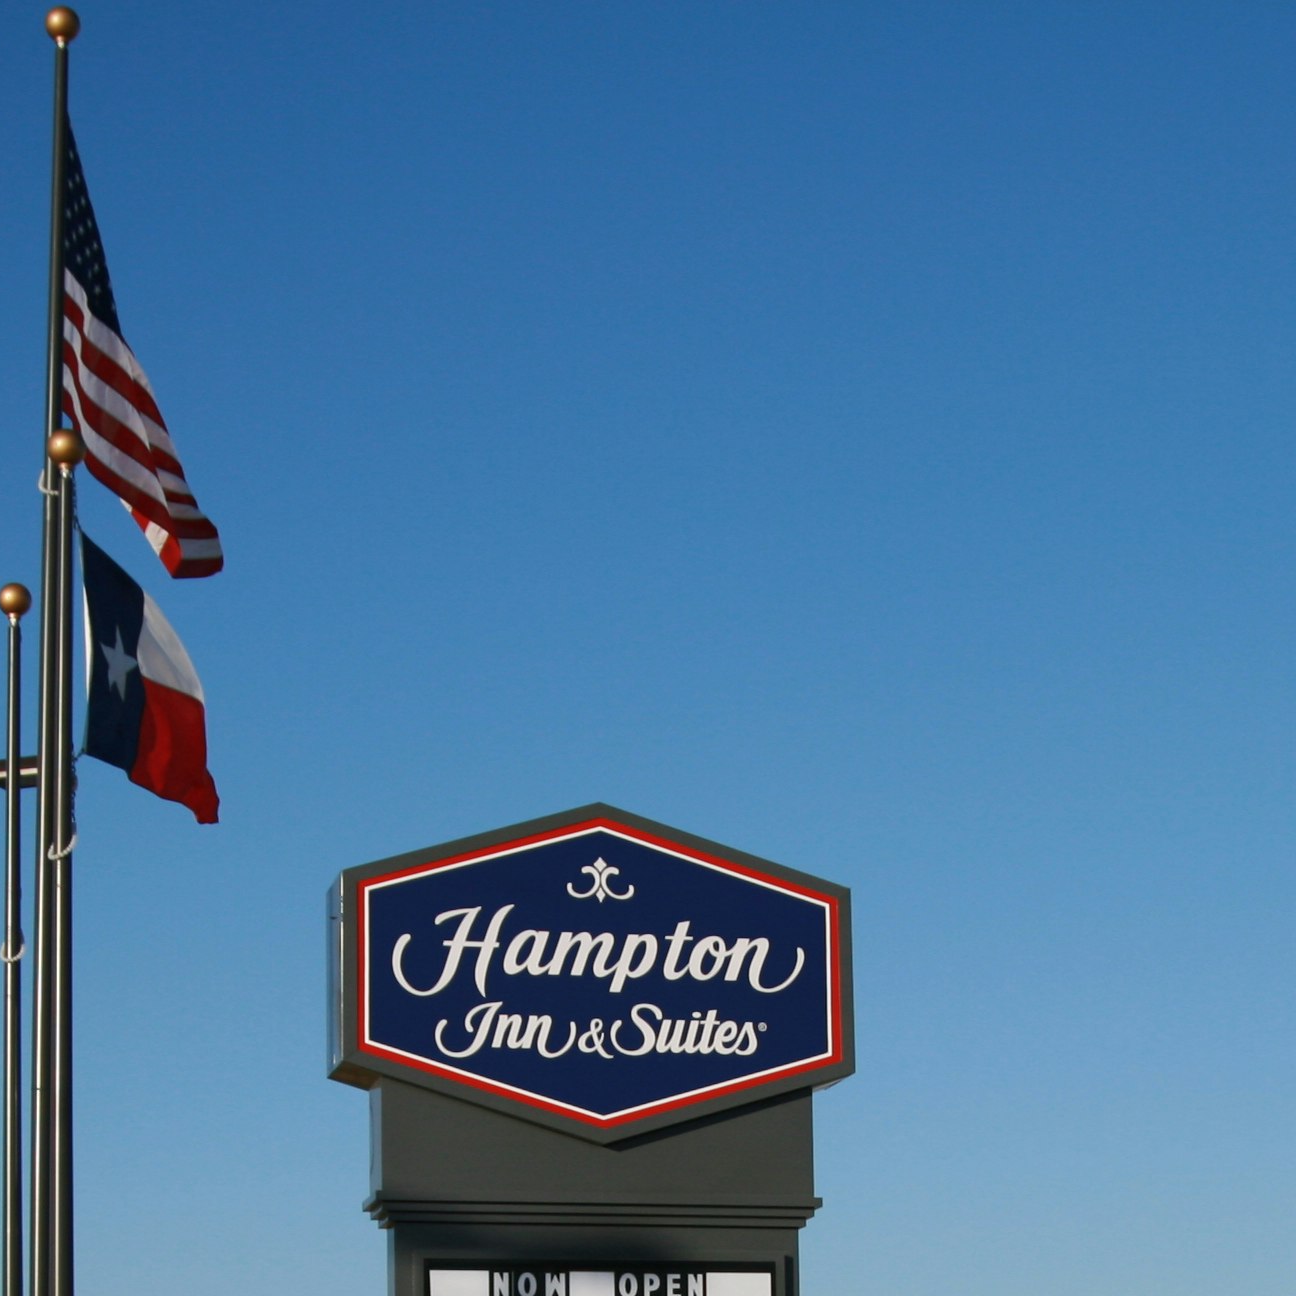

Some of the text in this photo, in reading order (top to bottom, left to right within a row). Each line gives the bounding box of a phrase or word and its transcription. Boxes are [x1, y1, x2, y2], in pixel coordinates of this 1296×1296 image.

[392, 904, 805, 997] Hampton
[435, 1002, 760, 1059] Inn & Suites
